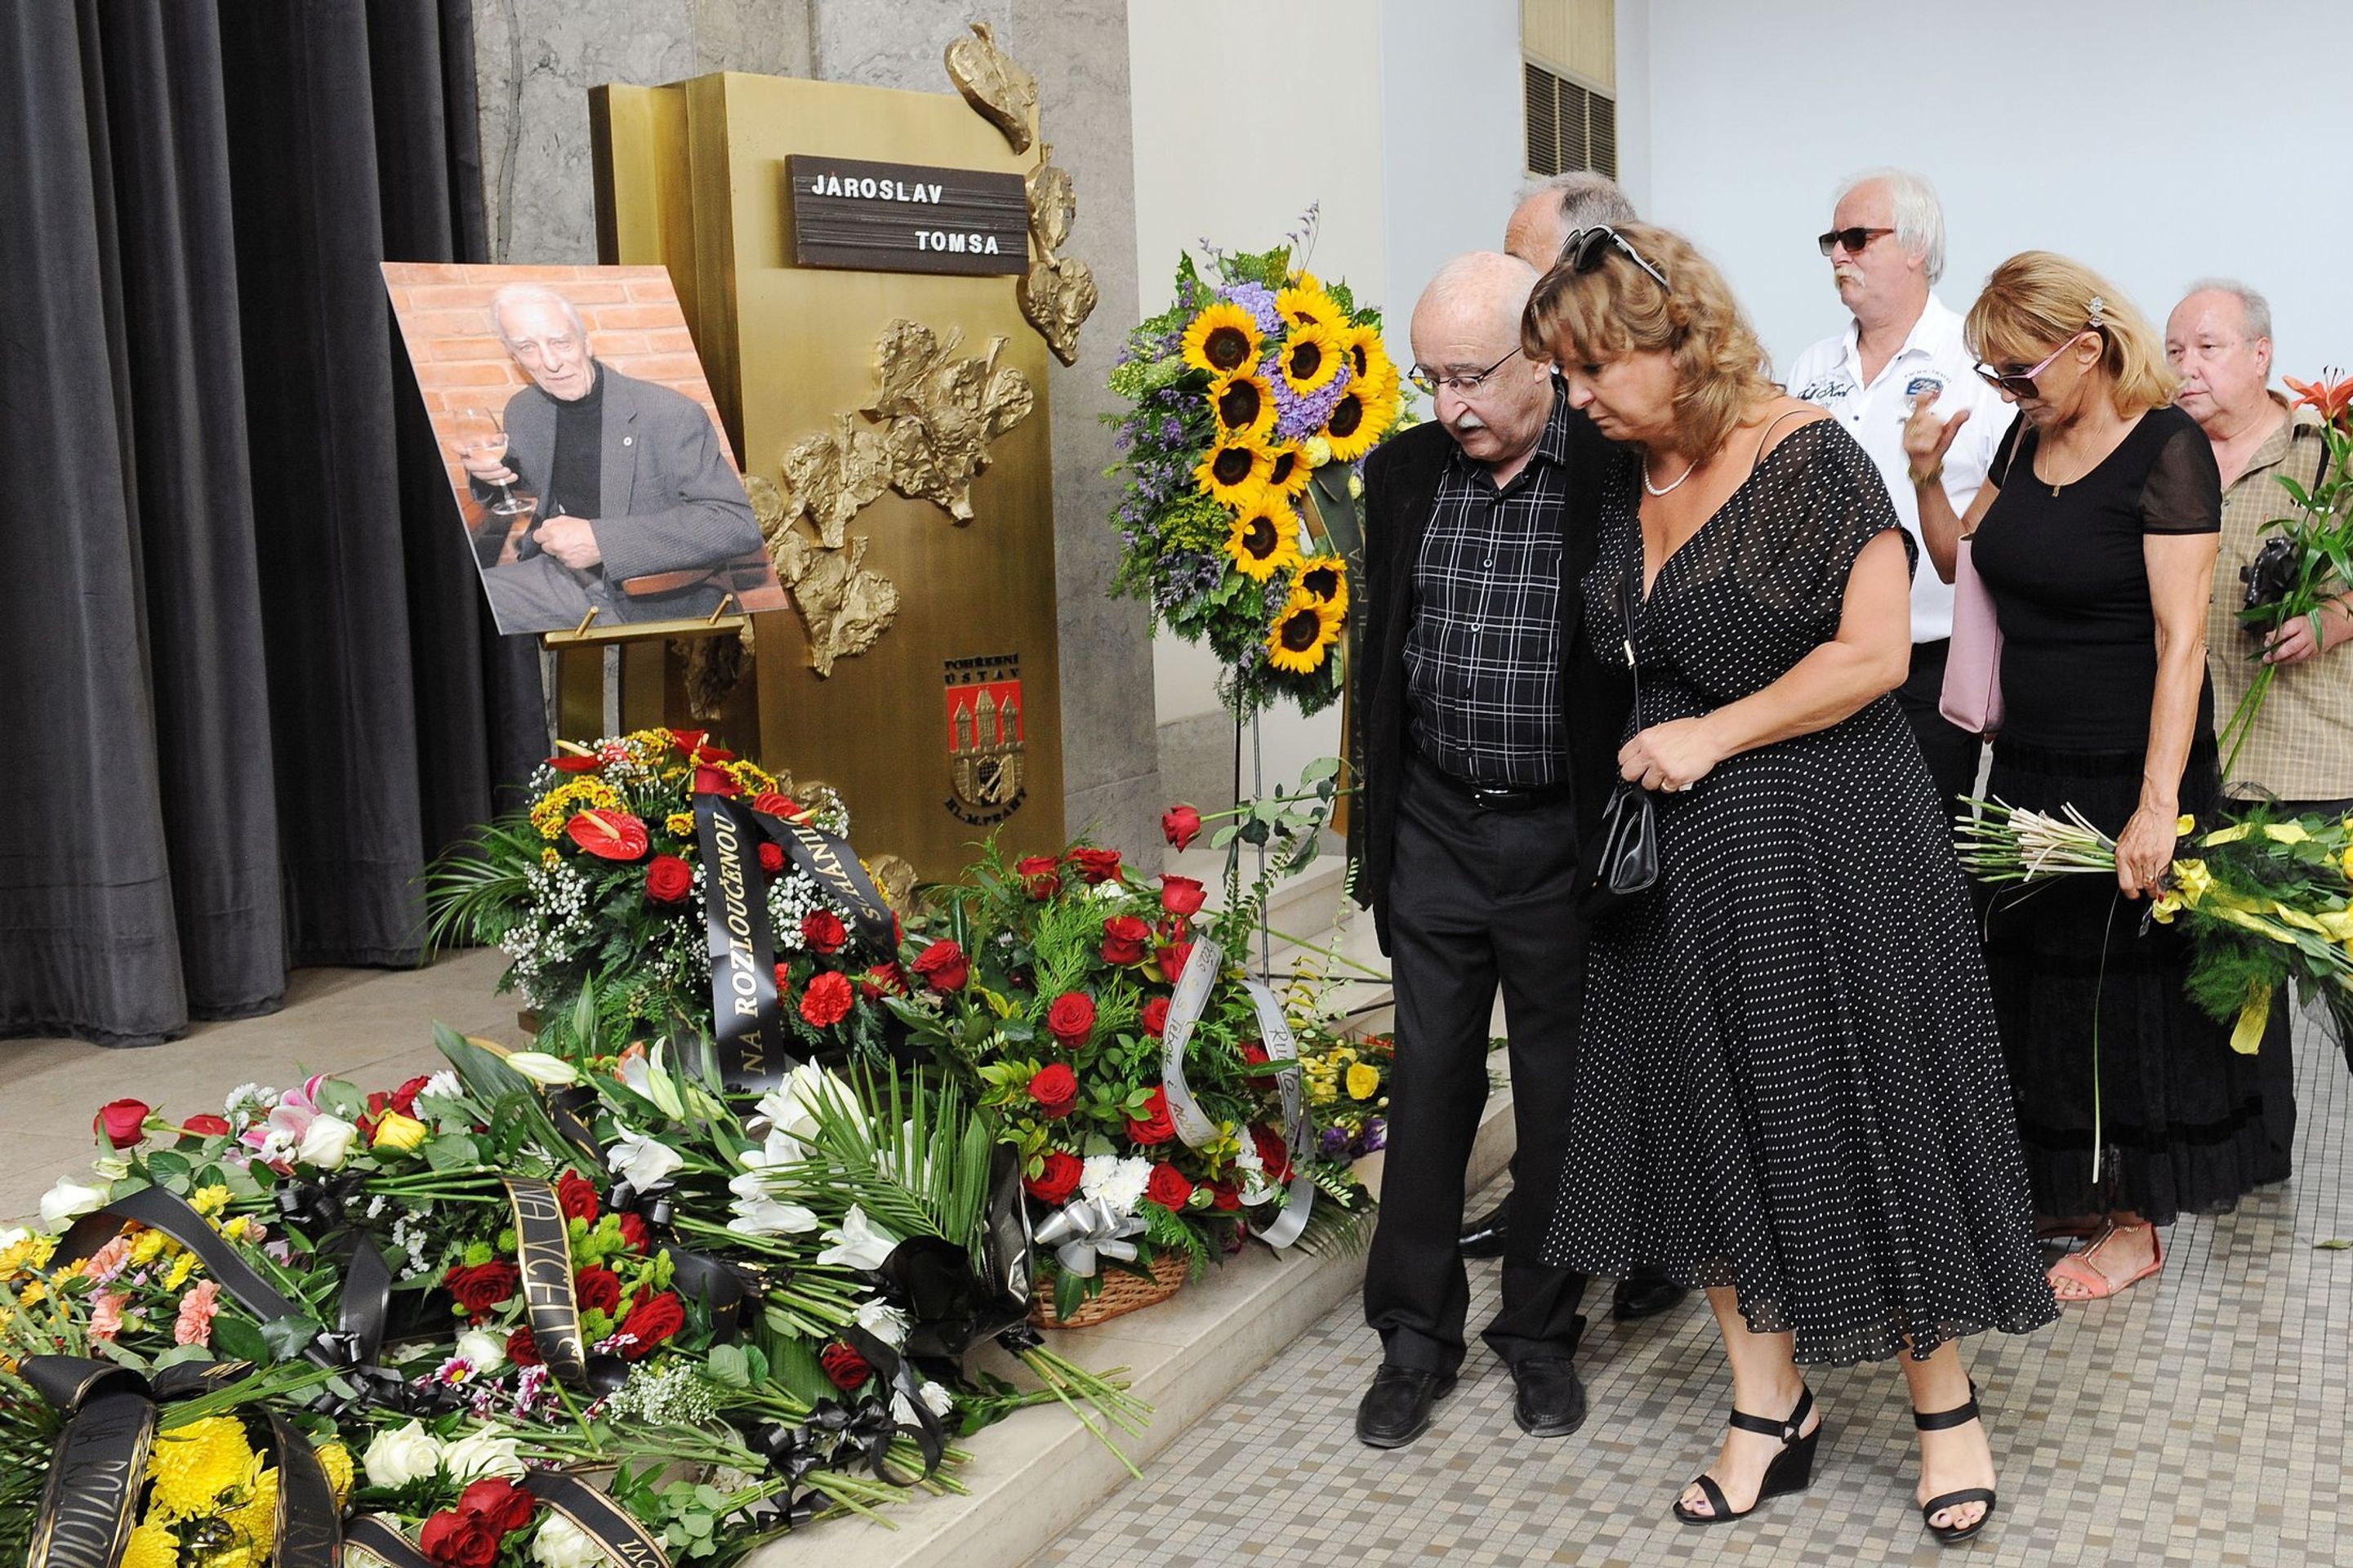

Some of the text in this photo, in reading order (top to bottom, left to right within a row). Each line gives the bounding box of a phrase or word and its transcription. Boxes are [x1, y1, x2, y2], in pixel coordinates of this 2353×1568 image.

[812, 174, 943, 204] JAROSLAV
[914, 230, 999, 255] TOMSA
[713, 811, 766, 1076] NA ROZLOUČENOU
